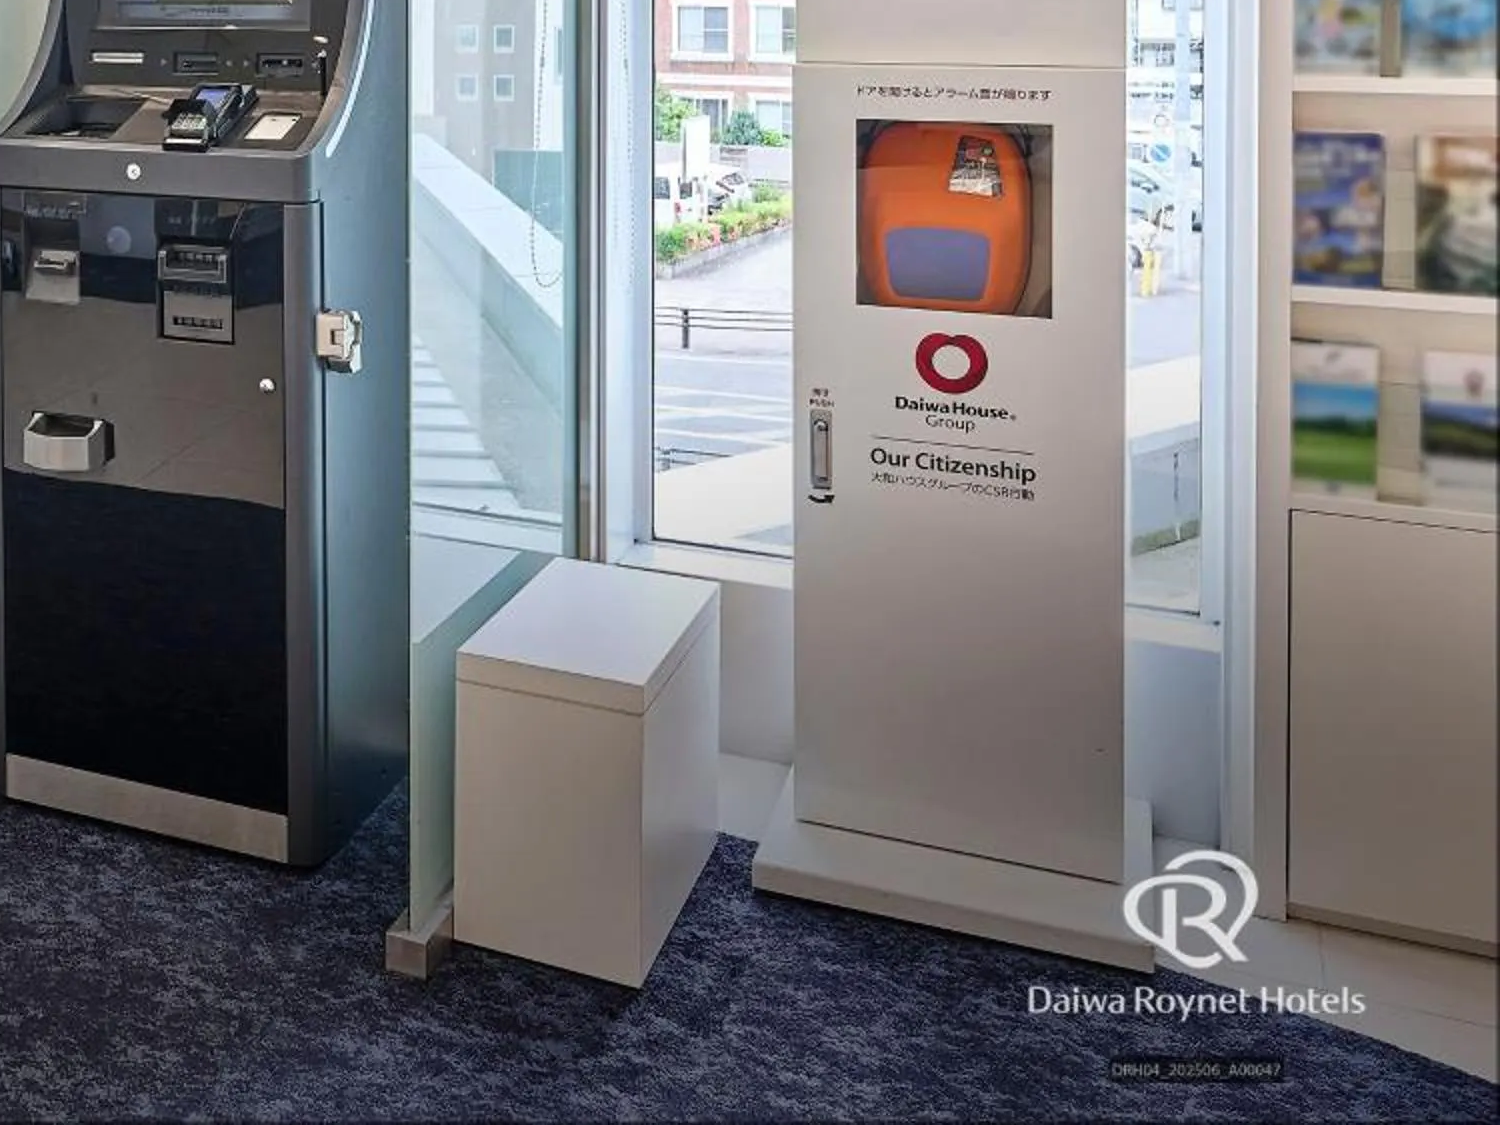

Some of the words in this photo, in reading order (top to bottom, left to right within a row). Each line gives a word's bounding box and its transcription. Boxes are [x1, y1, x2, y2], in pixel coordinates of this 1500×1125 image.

[925, 414, 975, 433] Group
[870, 447, 911, 468] Our
[915, 451, 1037, 485] Citizenship
